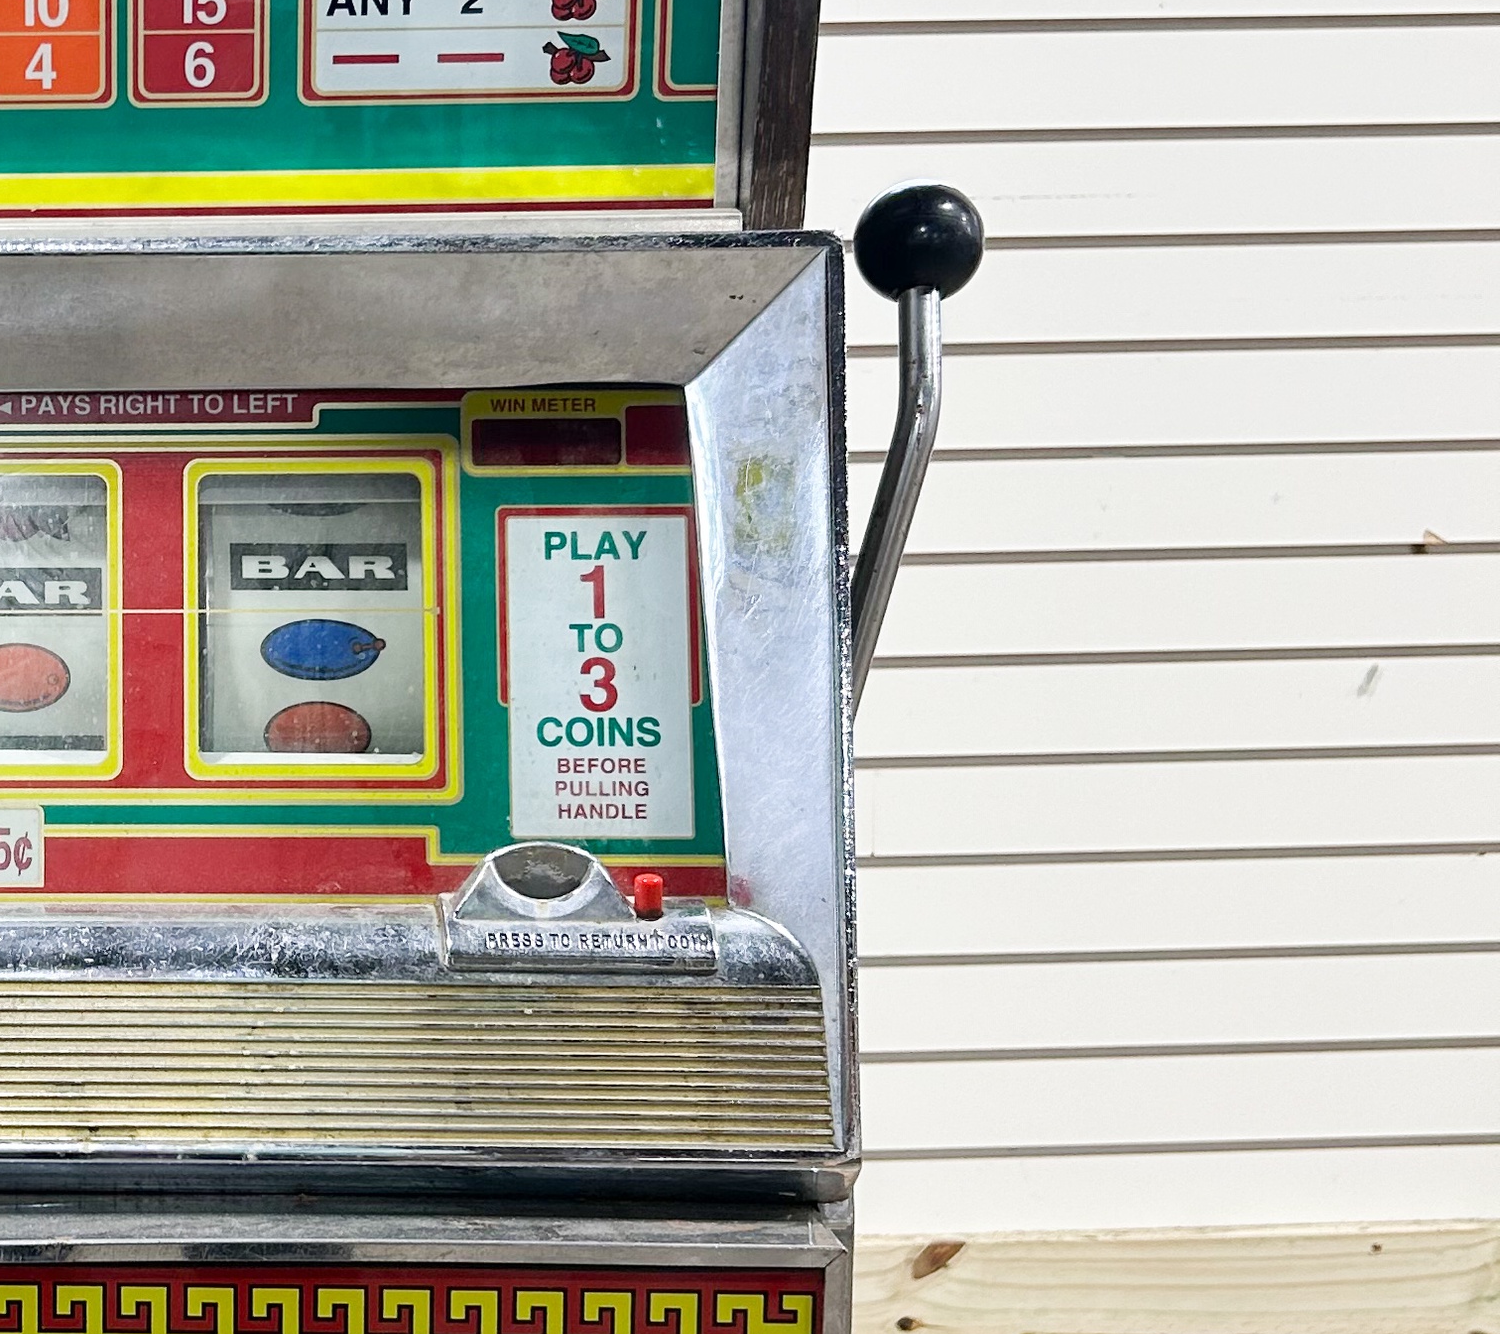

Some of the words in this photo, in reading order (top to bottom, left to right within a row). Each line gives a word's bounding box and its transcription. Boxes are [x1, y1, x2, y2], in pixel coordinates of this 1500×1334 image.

[25, 43, 57, 90] 4
[184, 41, 216, 88] 6
[21, 395, 91, 415] PAYS
[100, 394, 180, 415] RIGHT
[188, 394, 223, 414] TO
[233, 393, 298, 414] LEFT
[490, 399, 525, 412] WIN
[532, 398, 596, 412] METER
[544, 531, 647, 561] PLAY
[240, 554, 398, 580] BAR
[579, 565, 606, 619] 1
[568, 623, 624, 653] TO
[579, 657, 618, 713] 3
[536, 716, 661, 748] COINS
[557, 758, 647, 774] BEFORE
[555, 781, 649, 797] PULLING
[558, 804, 648, 820] HANDLE
[486, 932, 544, 949] PRESS
[550, 933, 571, 948] TO
[579, 932, 648, 949] RETURN
